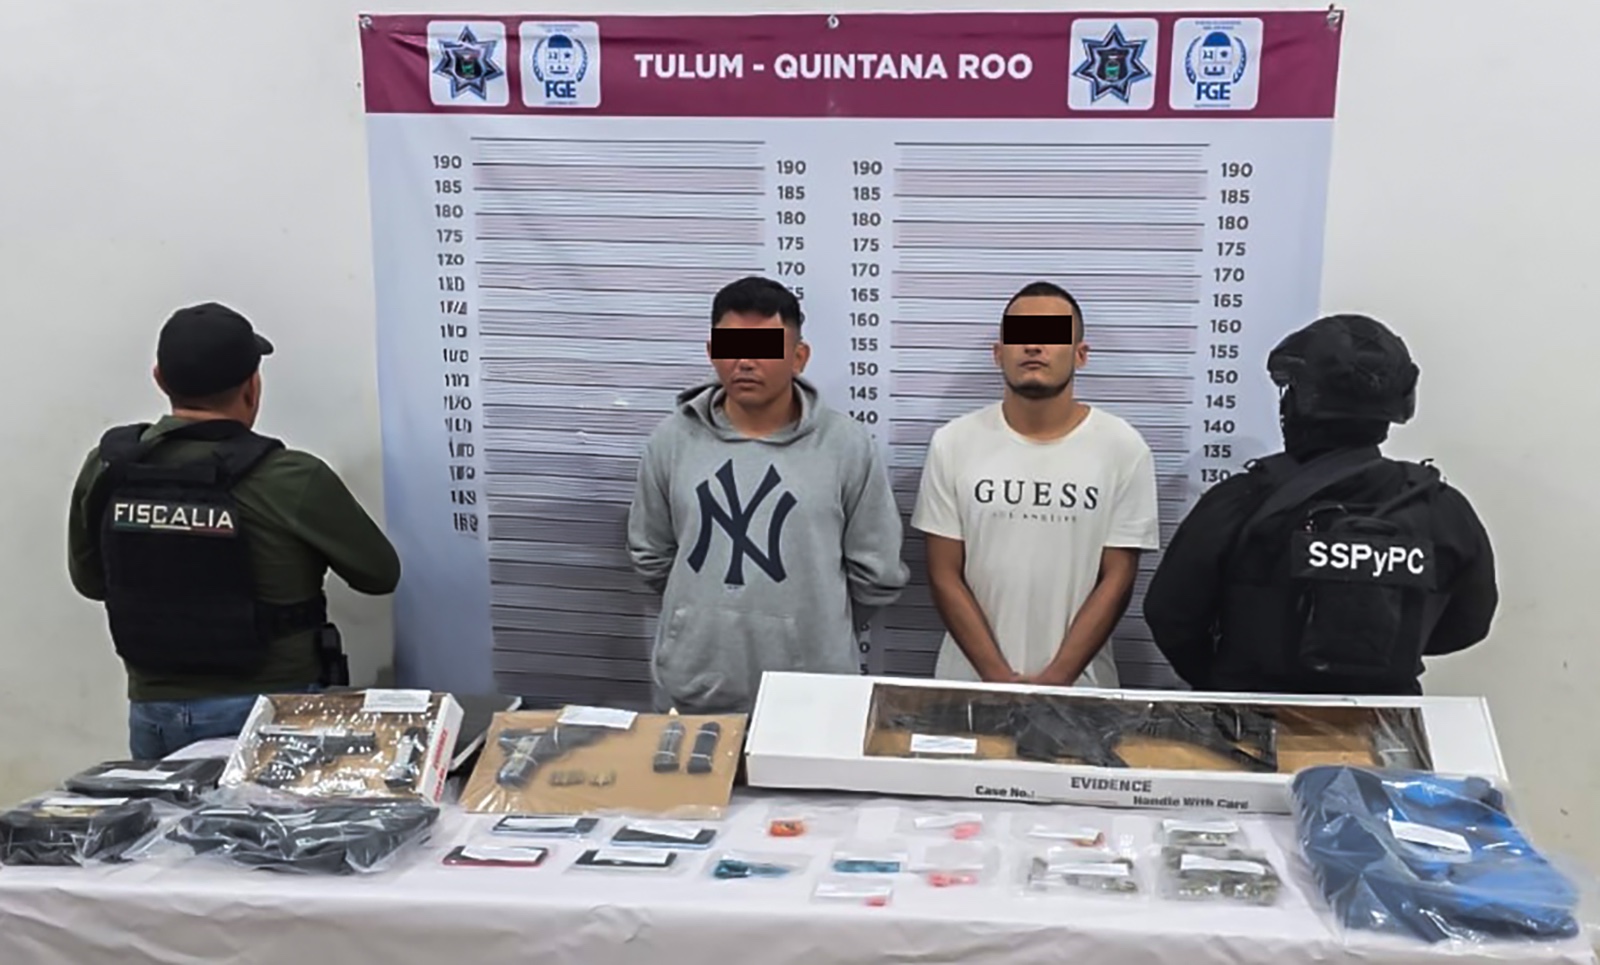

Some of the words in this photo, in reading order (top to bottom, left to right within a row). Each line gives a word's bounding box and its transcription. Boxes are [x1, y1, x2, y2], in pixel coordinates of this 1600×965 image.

[634, 53, 743, 79] TULUM
[773, 53, 945, 79] QUINTANA
[958, 53, 1033, 80] ROO
[545, 80, 576, 98] FGE
[1196, 81, 1232, 101] FGE
[433, 155, 462, 169] 190
[776, 159, 807, 175] 190
[852, 160, 883, 176] 190
[1221, 162, 1253, 178] 190
[434, 179, 463, 194] 185
[777, 185, 805, 200] 185
[853, 186, 881, 201] 185
[1220, 189, 1250, 204] 185
[434, 203, 464, 219] 180
[776, 210, 806, 225] 180
[852, 212, 882, 227] 180
[1217, 215, 1249, 231] 180
[436, 228, 463, 243] 175
[777, 236, 805, 251] 175
[853, 237, 880, 252] 175
[1217, 241, 1246, 257] 175
[776, 261, 806, 276] 170
[851, 262, 880, 278] 170
[1214, 267, 1245, 283] 170
[851, 287, 880, 303] 165
[1213, 293, 1243, 308] 165
[849, 312, 880, 327] 160
[1210, 319, 1242, 334] 160
[850, 337, 878, 352] 155
[1210, 344, 1239, 359] 155
[849, 361, 879, 377] 150
[1207, 369, 1239, 384] 150
[849, 385, 878, 401] 145
[1206, 394, 1236, 410] 145
[1203, 419, 1236, 434] 140
[1203, 444, 1232, 459] 135
[1201, 468, 1230, 482] 130
[974, 479, 1099, 510] GUESS
[115, 503, 234, 529] FISCALIA
[1309, 541, 1424, 577] SSPyPC
[975, 785, 1007, 797] Case
[1071, 777, 1152, 792] EVIDENCE
[1133, 796, 1180, 807] Handle
[1184, 797, 1214, 807] With
